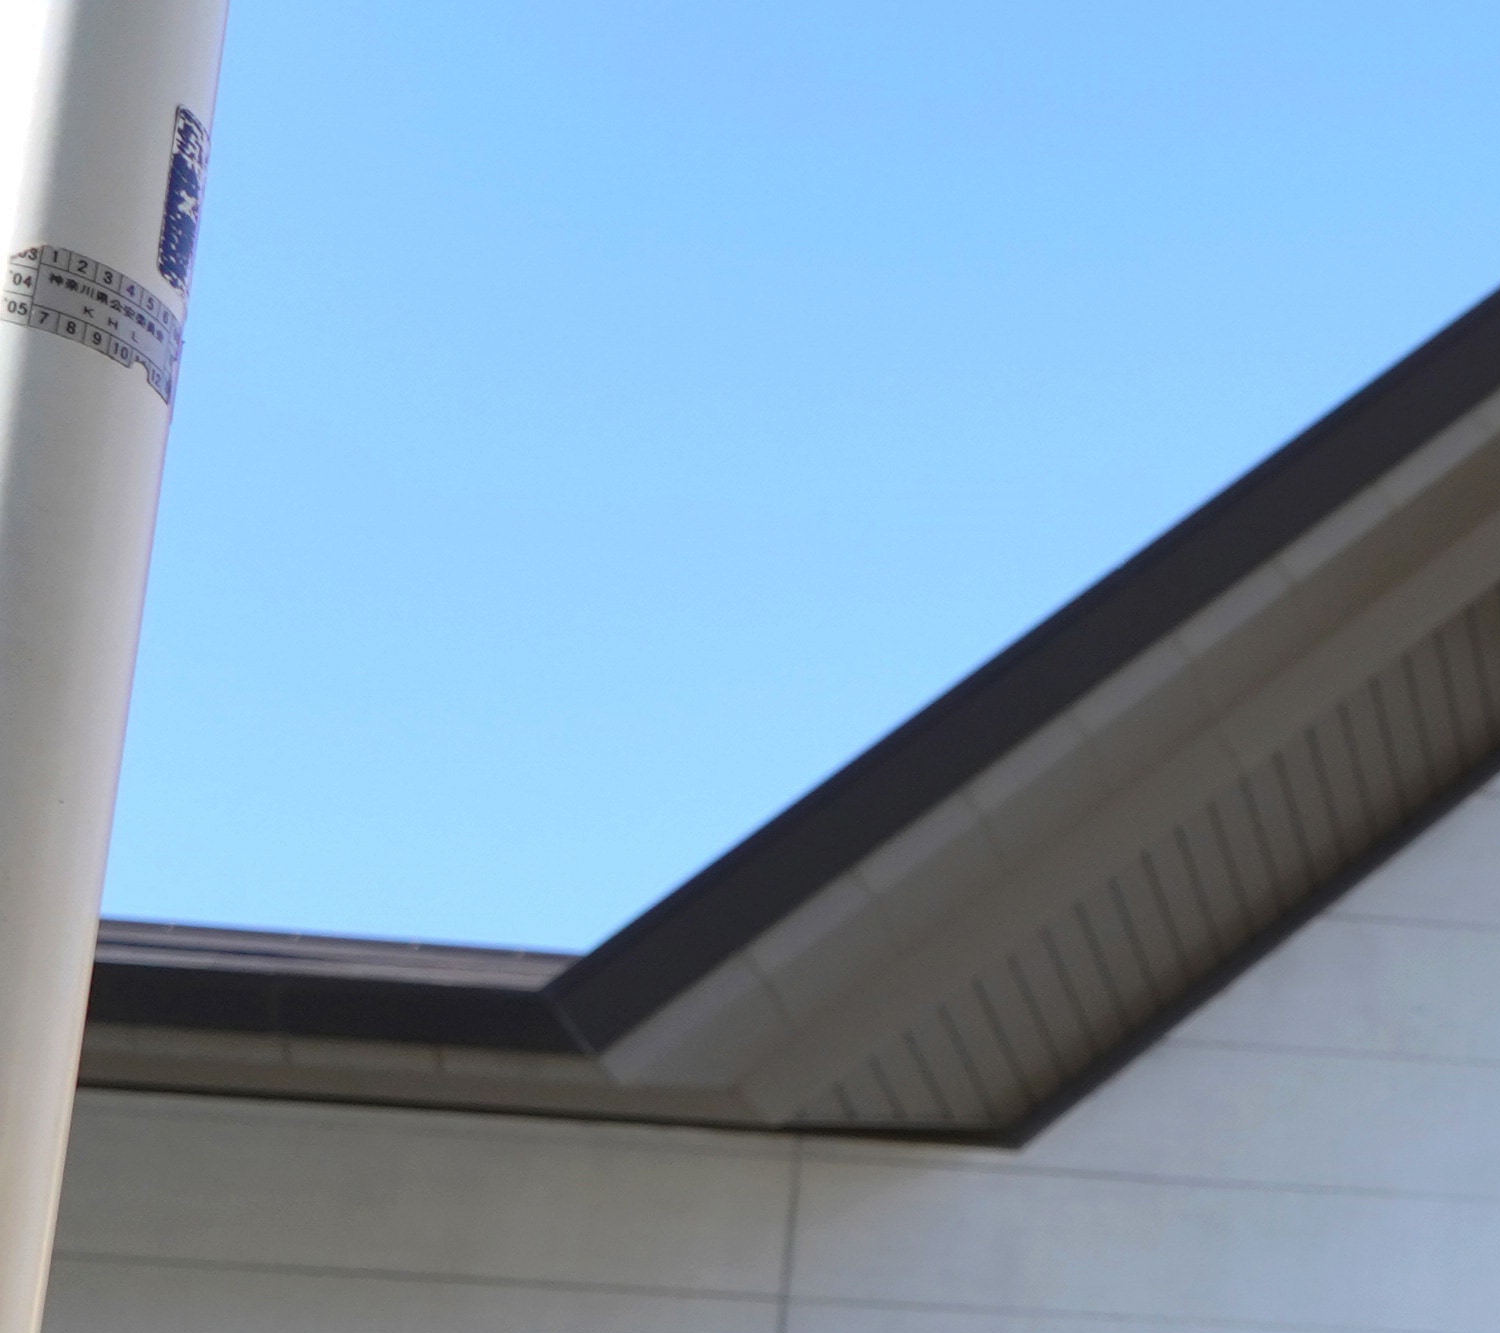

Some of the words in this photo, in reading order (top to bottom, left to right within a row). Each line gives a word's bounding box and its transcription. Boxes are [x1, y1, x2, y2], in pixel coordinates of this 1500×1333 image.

[52, 251, 58, 264] 1
[78, 259, 88, 274] 2
[102, 271, 114, 285] 3
[125, 284, 136, 298] 4
[147, 297, 155, 311] 5
[38, 311, 50, 325] 7
[65, 320, 77, 336] 8
[92, 331, 103, 346] 9
[113, 341, 129, 361] 10
